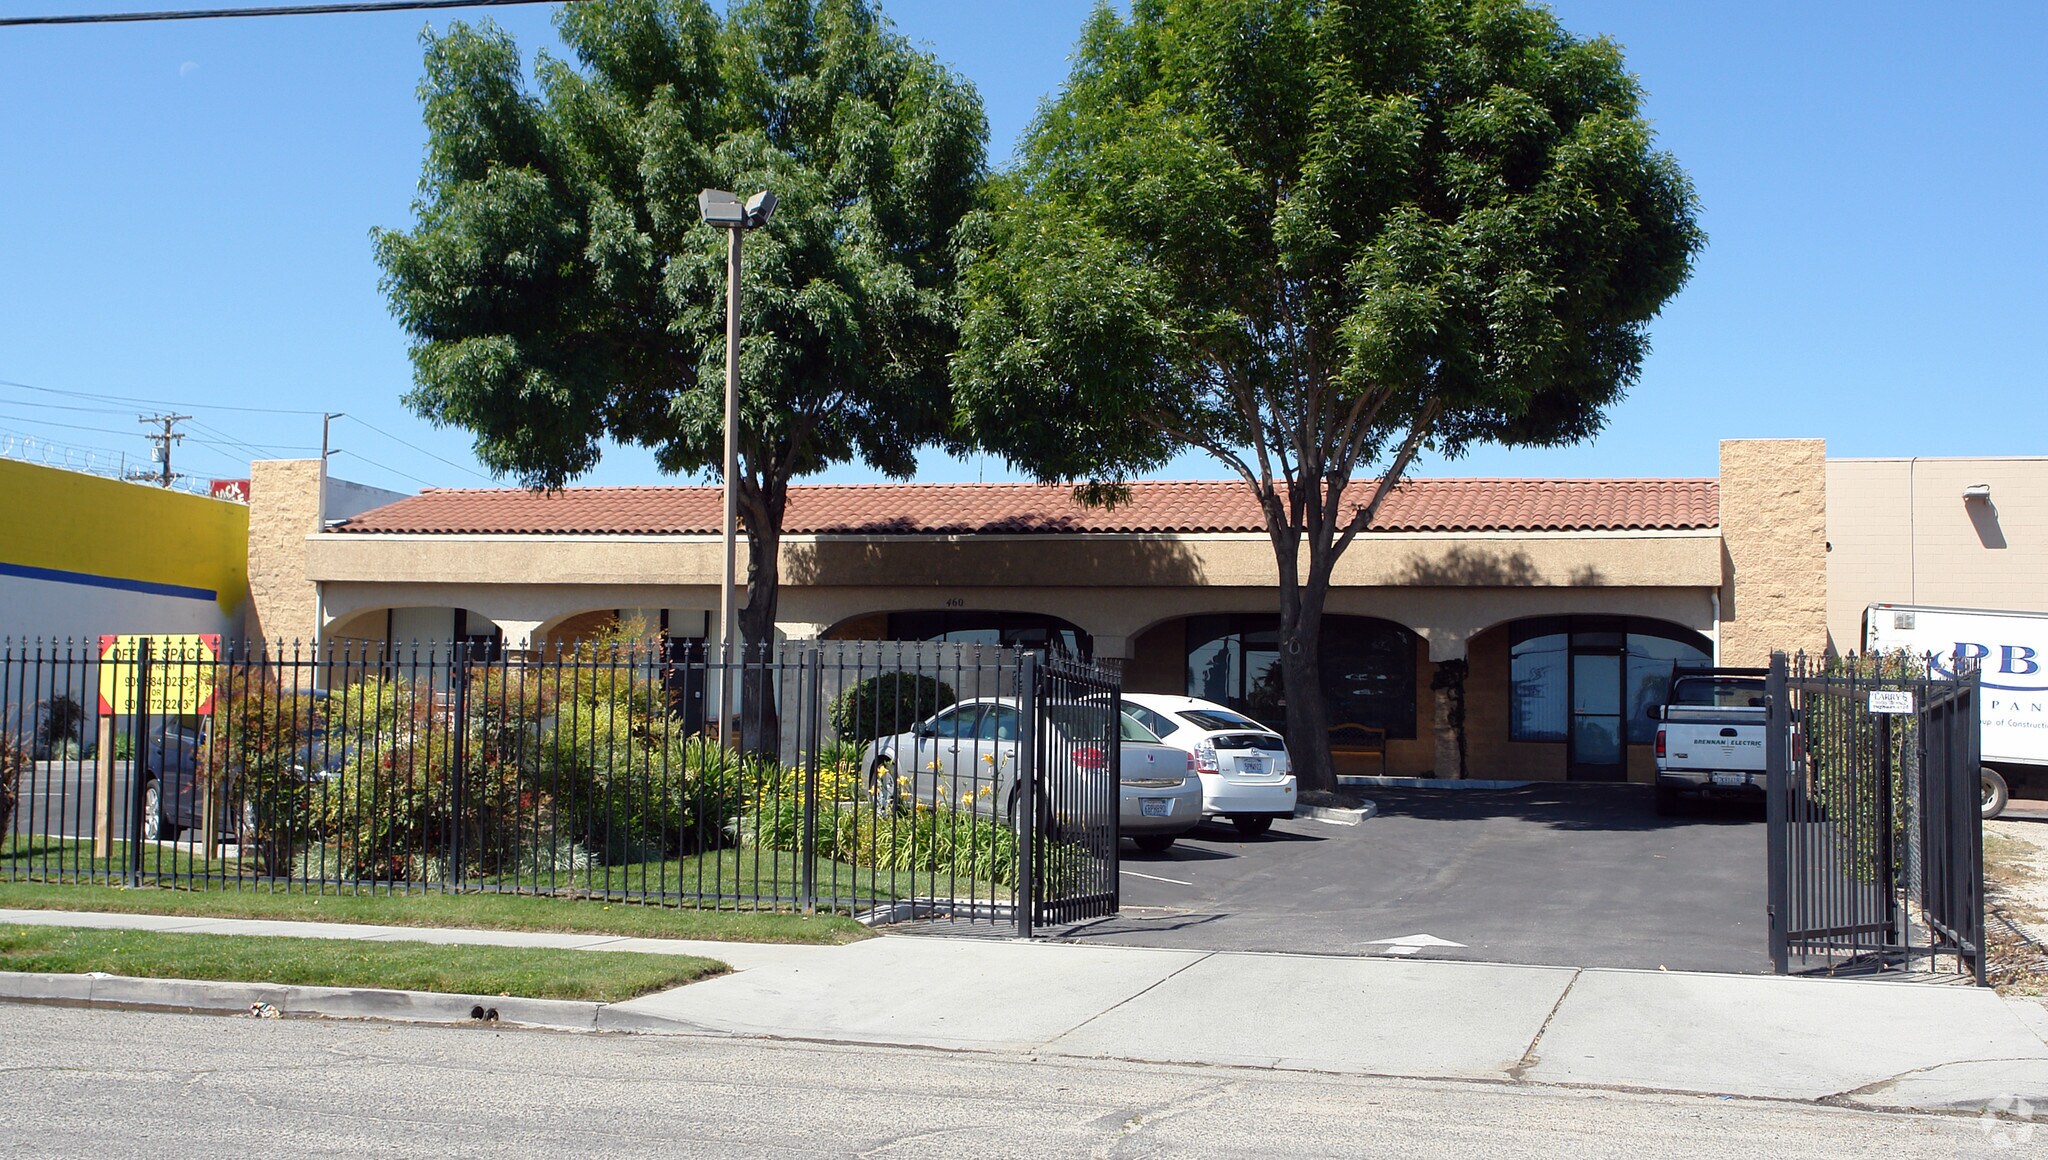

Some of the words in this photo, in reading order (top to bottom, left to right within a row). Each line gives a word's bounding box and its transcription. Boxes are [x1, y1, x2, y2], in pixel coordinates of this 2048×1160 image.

[946, 599, 964, 607] 460
[112, 648, 157, 660] OFFE
[161, 648, 204, 660] SPACE
[1995, 718, 2004, 726] of
[2008, 718, 2048, 729] Constructi
